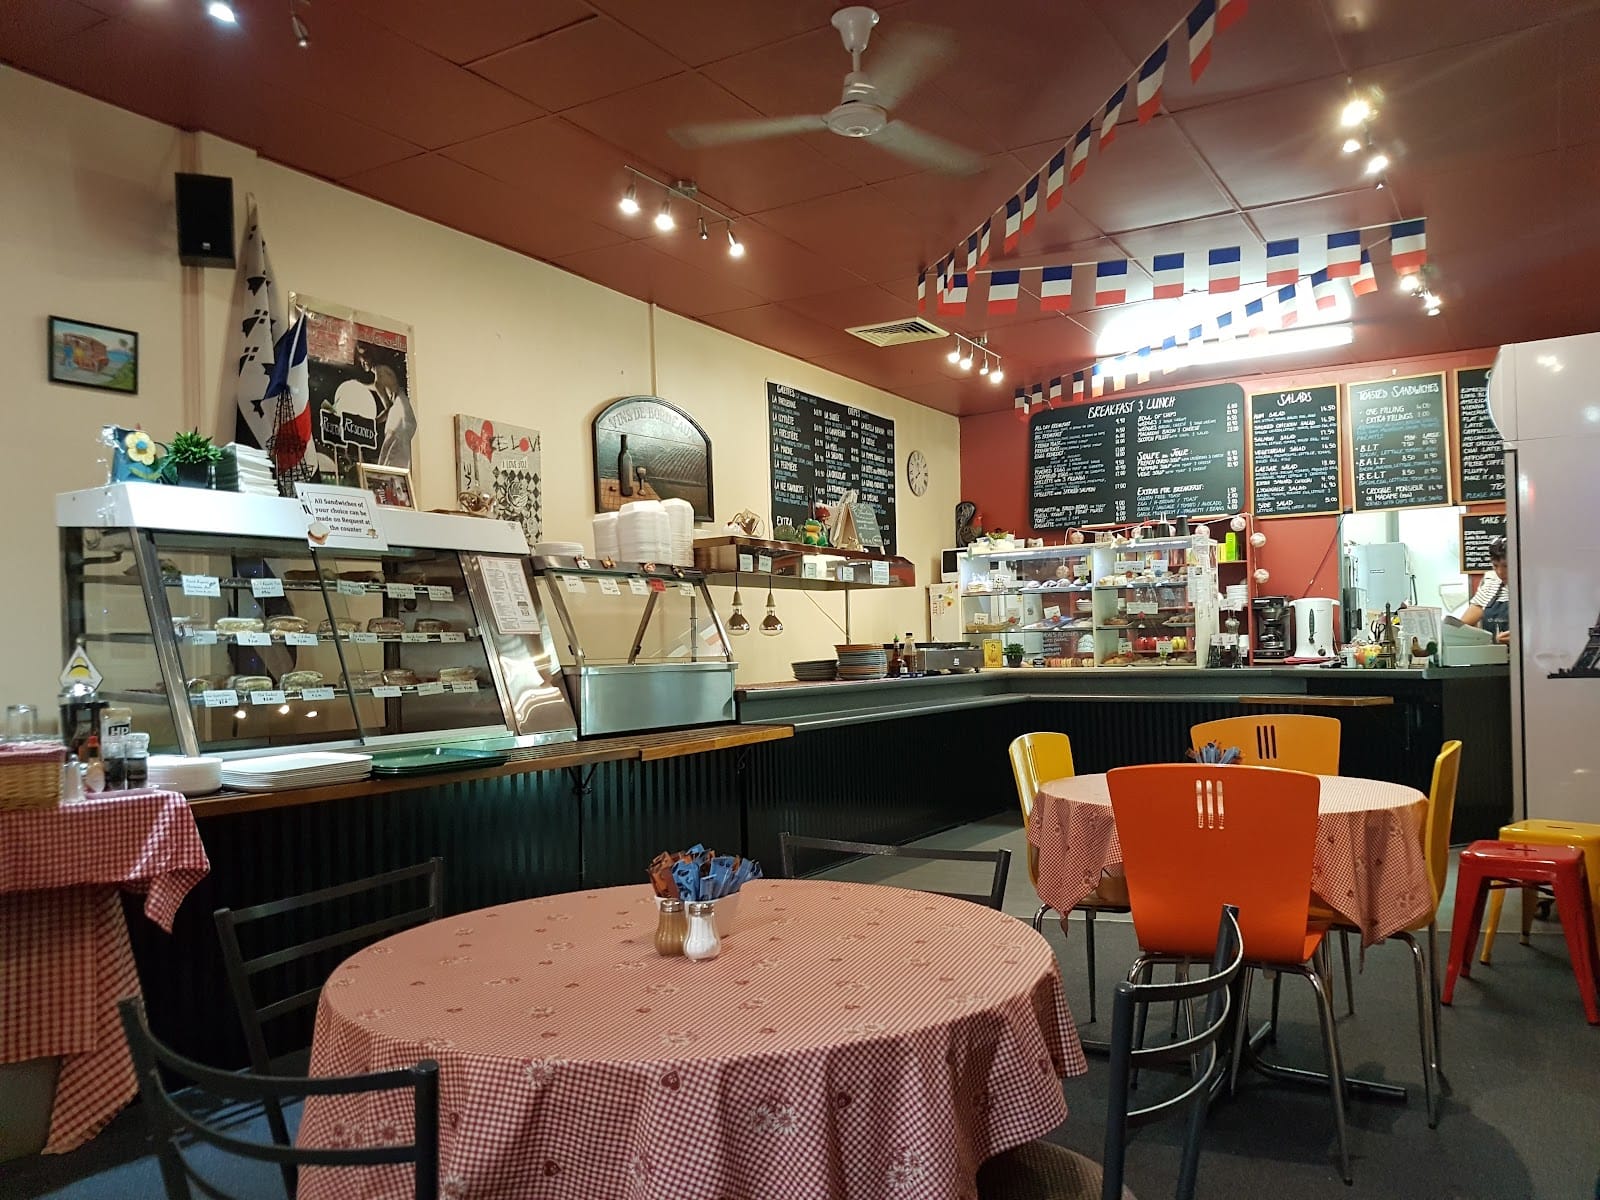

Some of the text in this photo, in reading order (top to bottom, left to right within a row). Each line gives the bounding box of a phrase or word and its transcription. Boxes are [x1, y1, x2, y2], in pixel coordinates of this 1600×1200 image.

[1356, 382, 1439, 401] TOASTED SANDWICHES
[1277, 391, 1313, 407] SALADS
[1087, 401, 1135, 419] BREAKFAST
[1146, 396, 1176, 410] LUNCH
[1379, 405, 1405, 414] FILLING
[608, 408, 634, 428] VINS
[634, 406, 647, 419] DE
[1463, 453, 1496, 461] AFFOGATO
[1463, 467, 1488, 475] FLUFFY
[1465, 491, 1487, 499] PLEASE
[323, 498, 357, 508] Sandwiches
[341, 517, 364, 525] Request
[776, 515, 793, 527] EXTRA
[110, 726, 129, 736] HP
